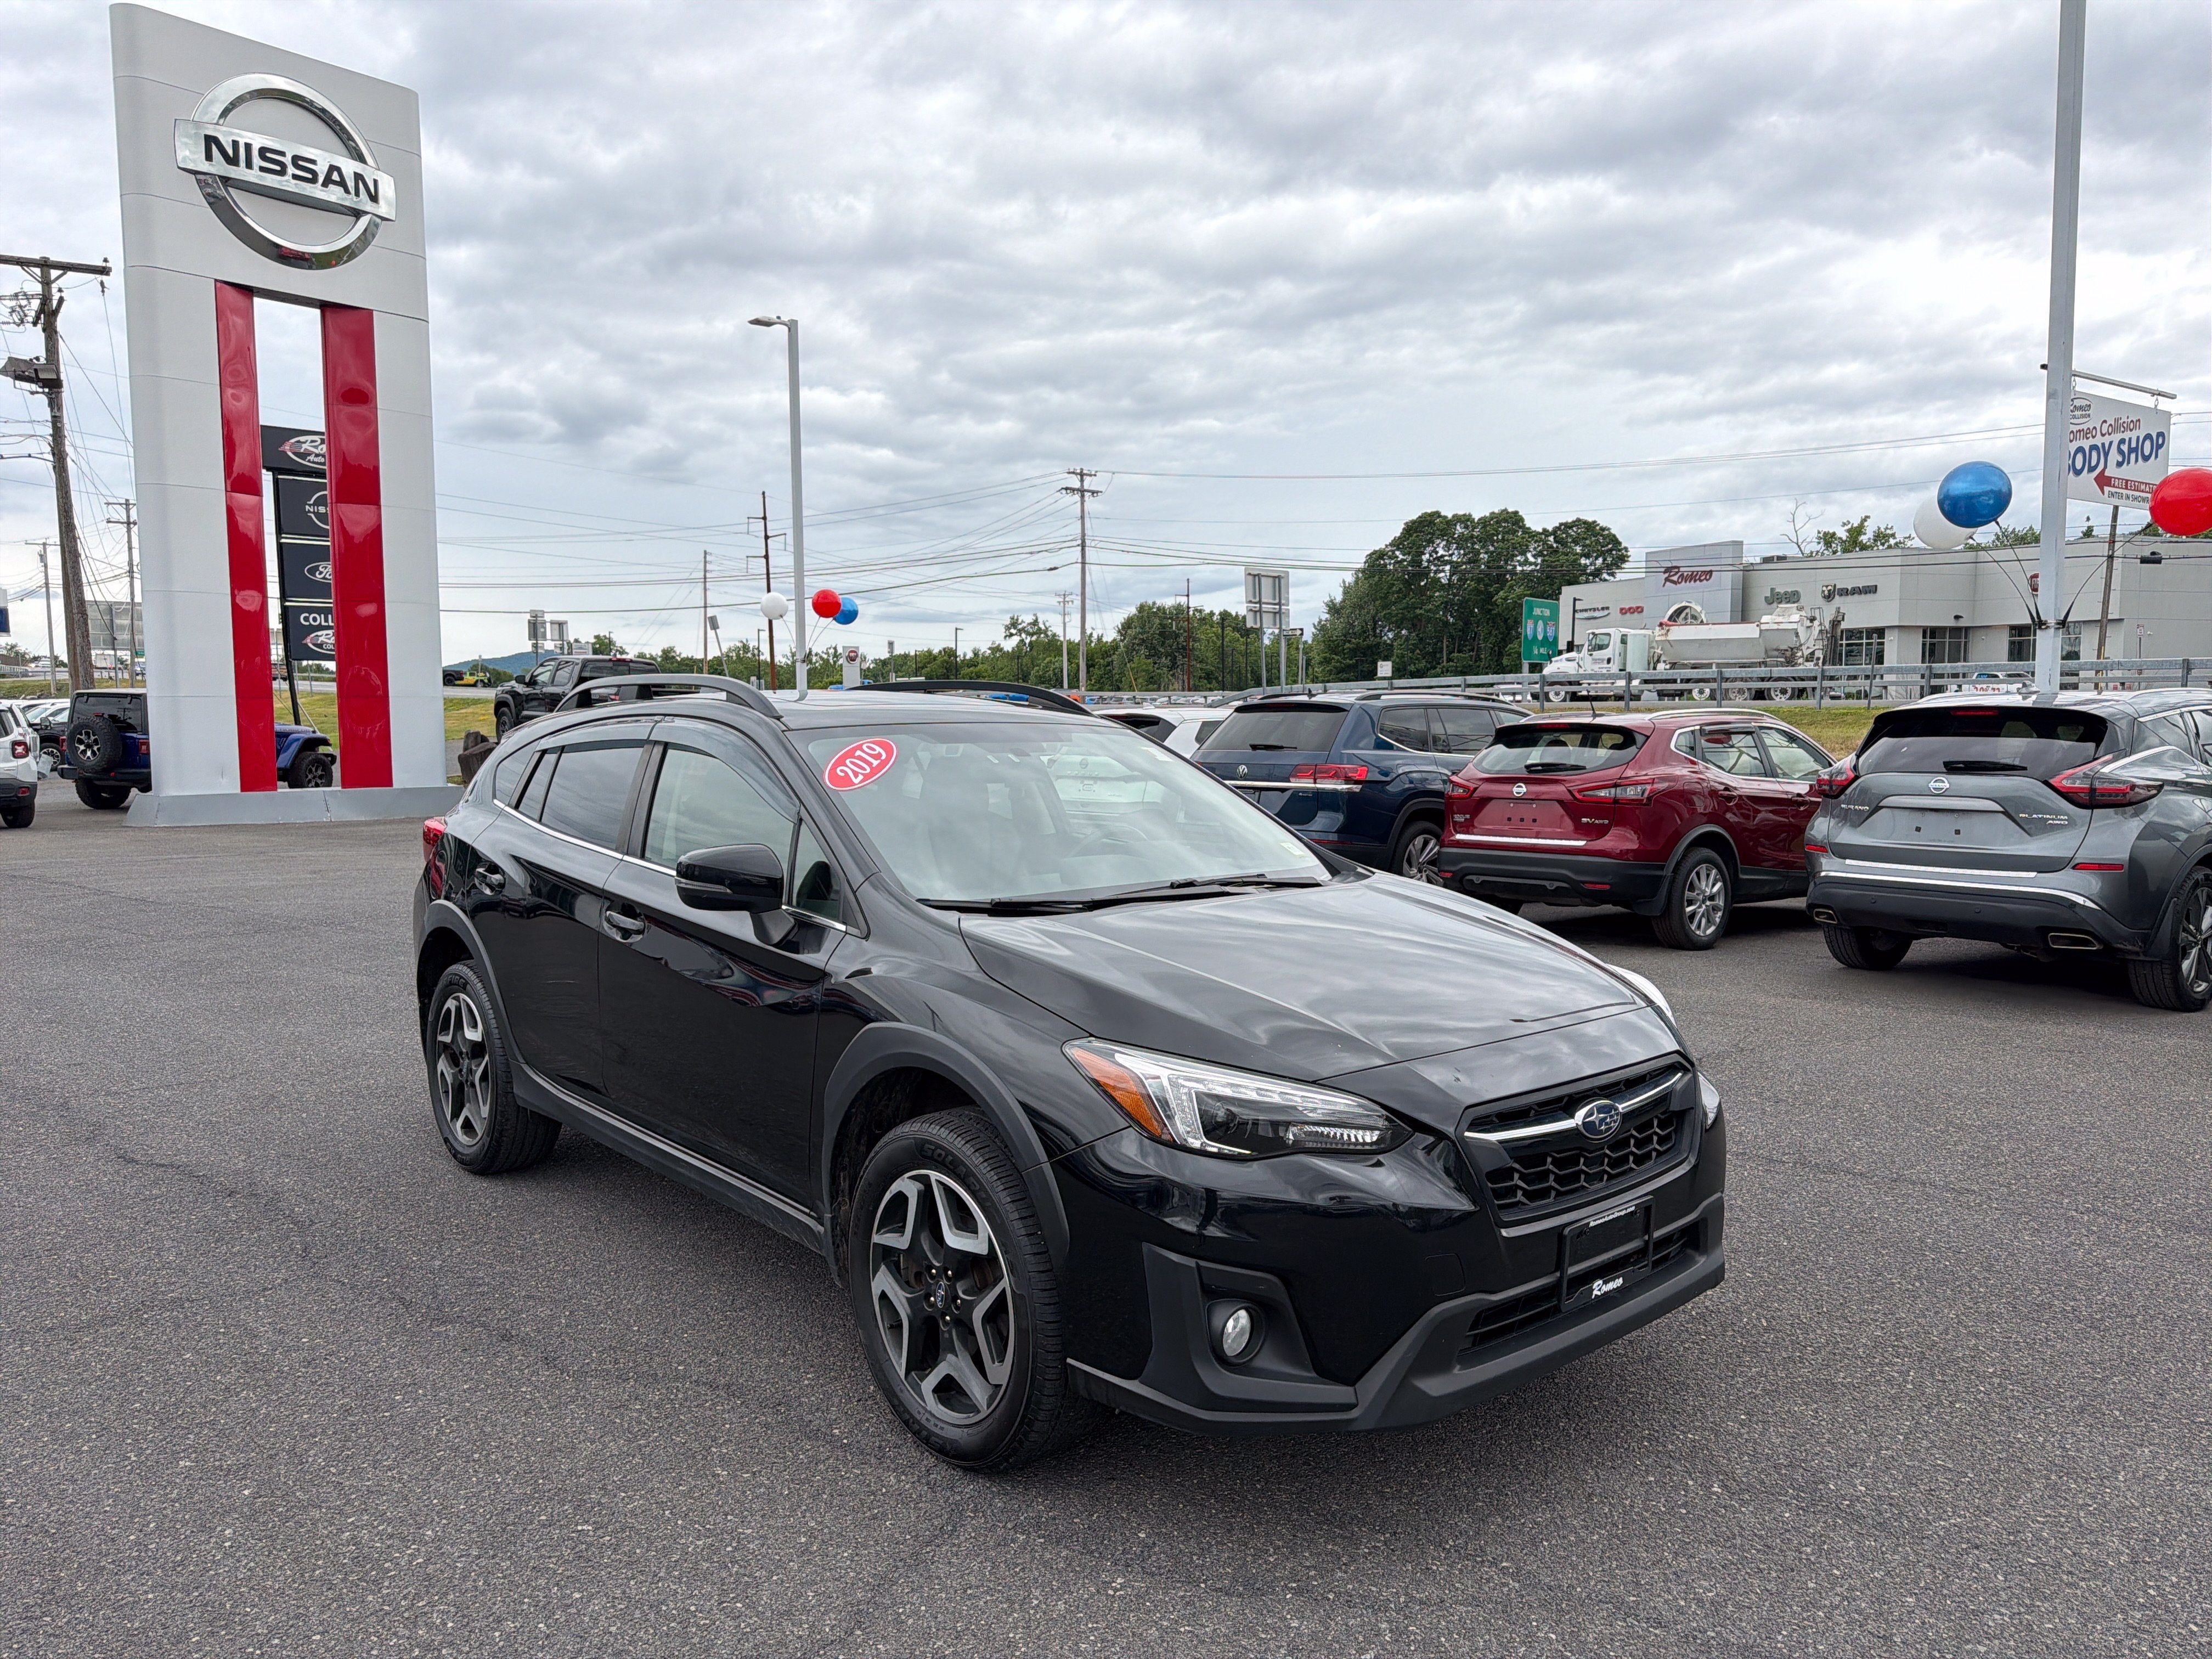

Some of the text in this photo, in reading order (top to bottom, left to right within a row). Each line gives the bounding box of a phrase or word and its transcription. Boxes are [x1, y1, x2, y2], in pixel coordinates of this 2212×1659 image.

[204, 133, 381, 205] NISSAN
[2069, 415, 2141, 443] omeo Collision
[306, 454, 325, 462] Auto
[2115, 431, 2166, 469] SHOP
[2111, 478, 2126, 488] FREE
[2107, 490, 2124, 500] ENTER
[2124, 493, 2130, 501] IN
[305, 505, 329, 514] NIS
[1662, 566, 1713, 588] Romeo
[1764, 588, 1801, 604] Jeep
[1837, 585, 1877, 597] RAM
[1532, 607, 1550, 616] JUNCTION
[836, 743, 887, 784] 2019
[1592, 1277, 1623, 1299] Romeo
